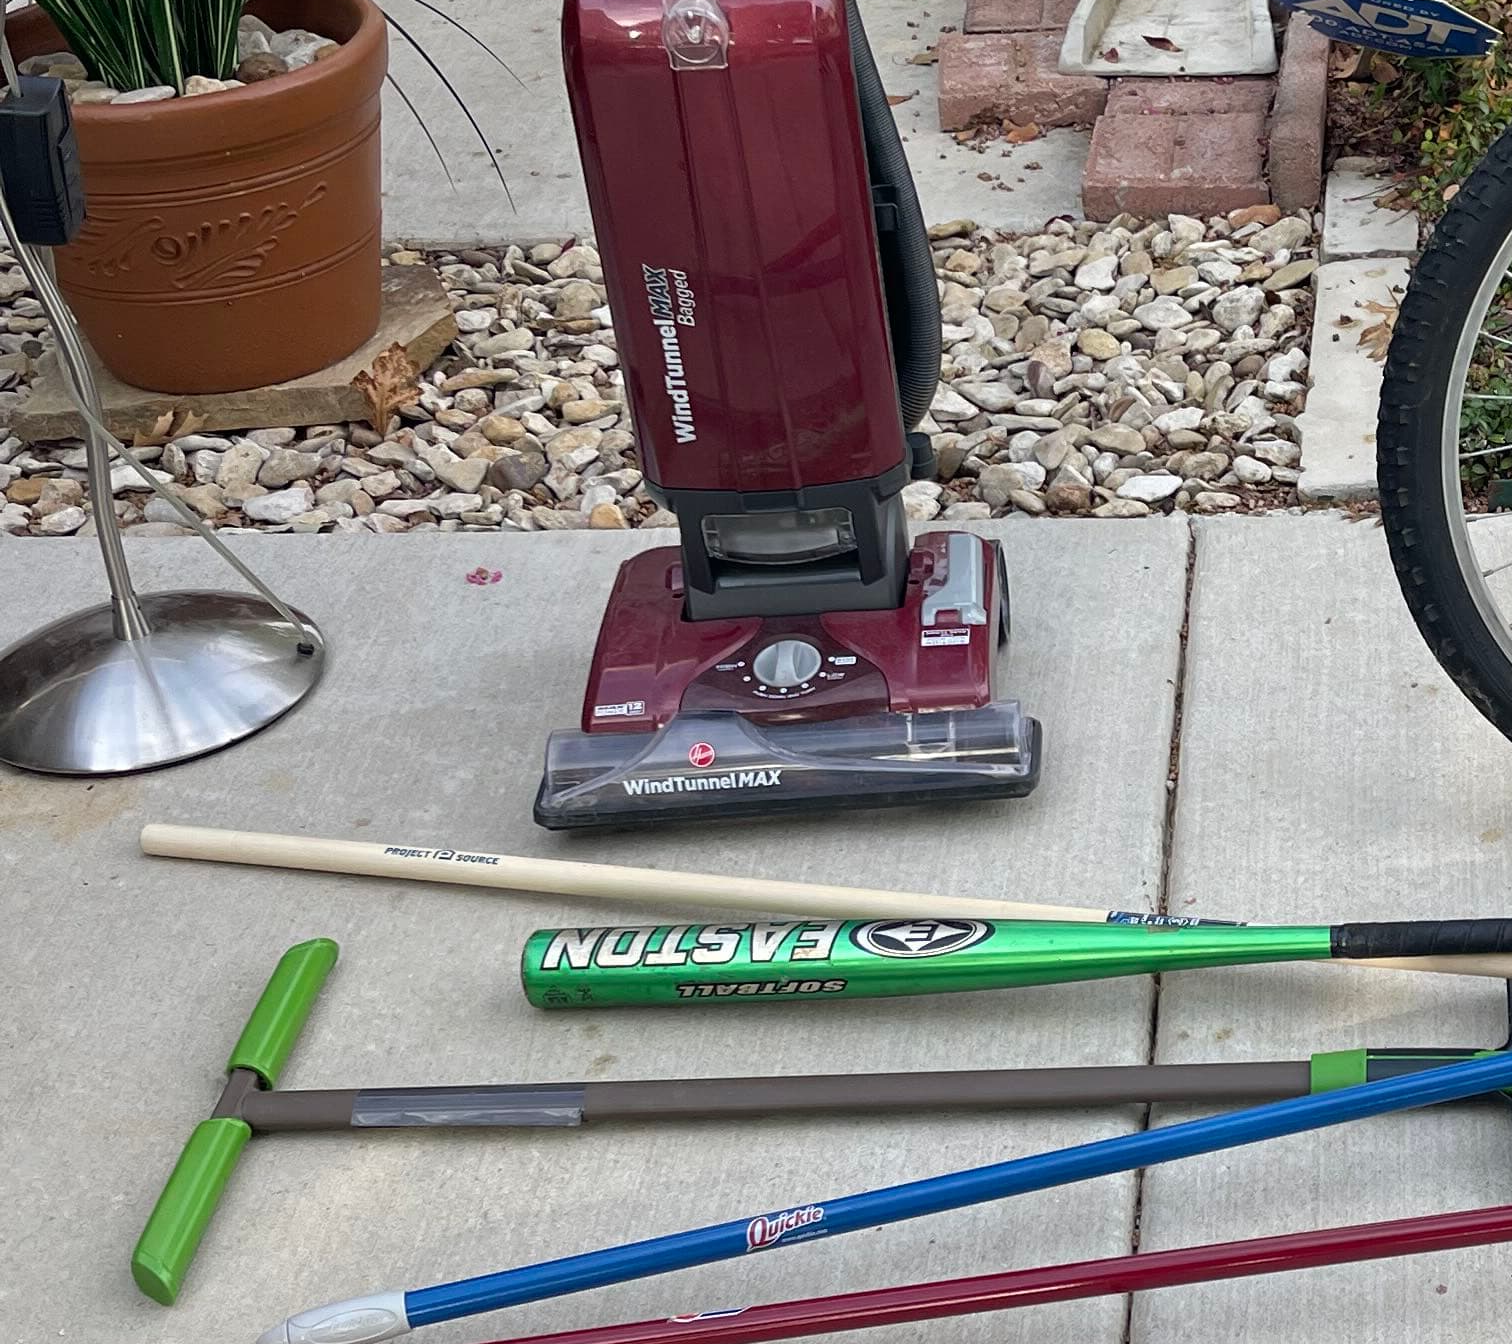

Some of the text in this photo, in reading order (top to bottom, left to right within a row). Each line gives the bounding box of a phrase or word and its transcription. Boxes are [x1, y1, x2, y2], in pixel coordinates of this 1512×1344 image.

[667, 268, 696, 328] Bagged
[384, 846, 501, 866] PROJECT SOURCE
[539, 919, 849, 971] EASTON
[675, 978, 847, 1000] SOFTBALL
[746, 1205, 825, 1253] Quickie
